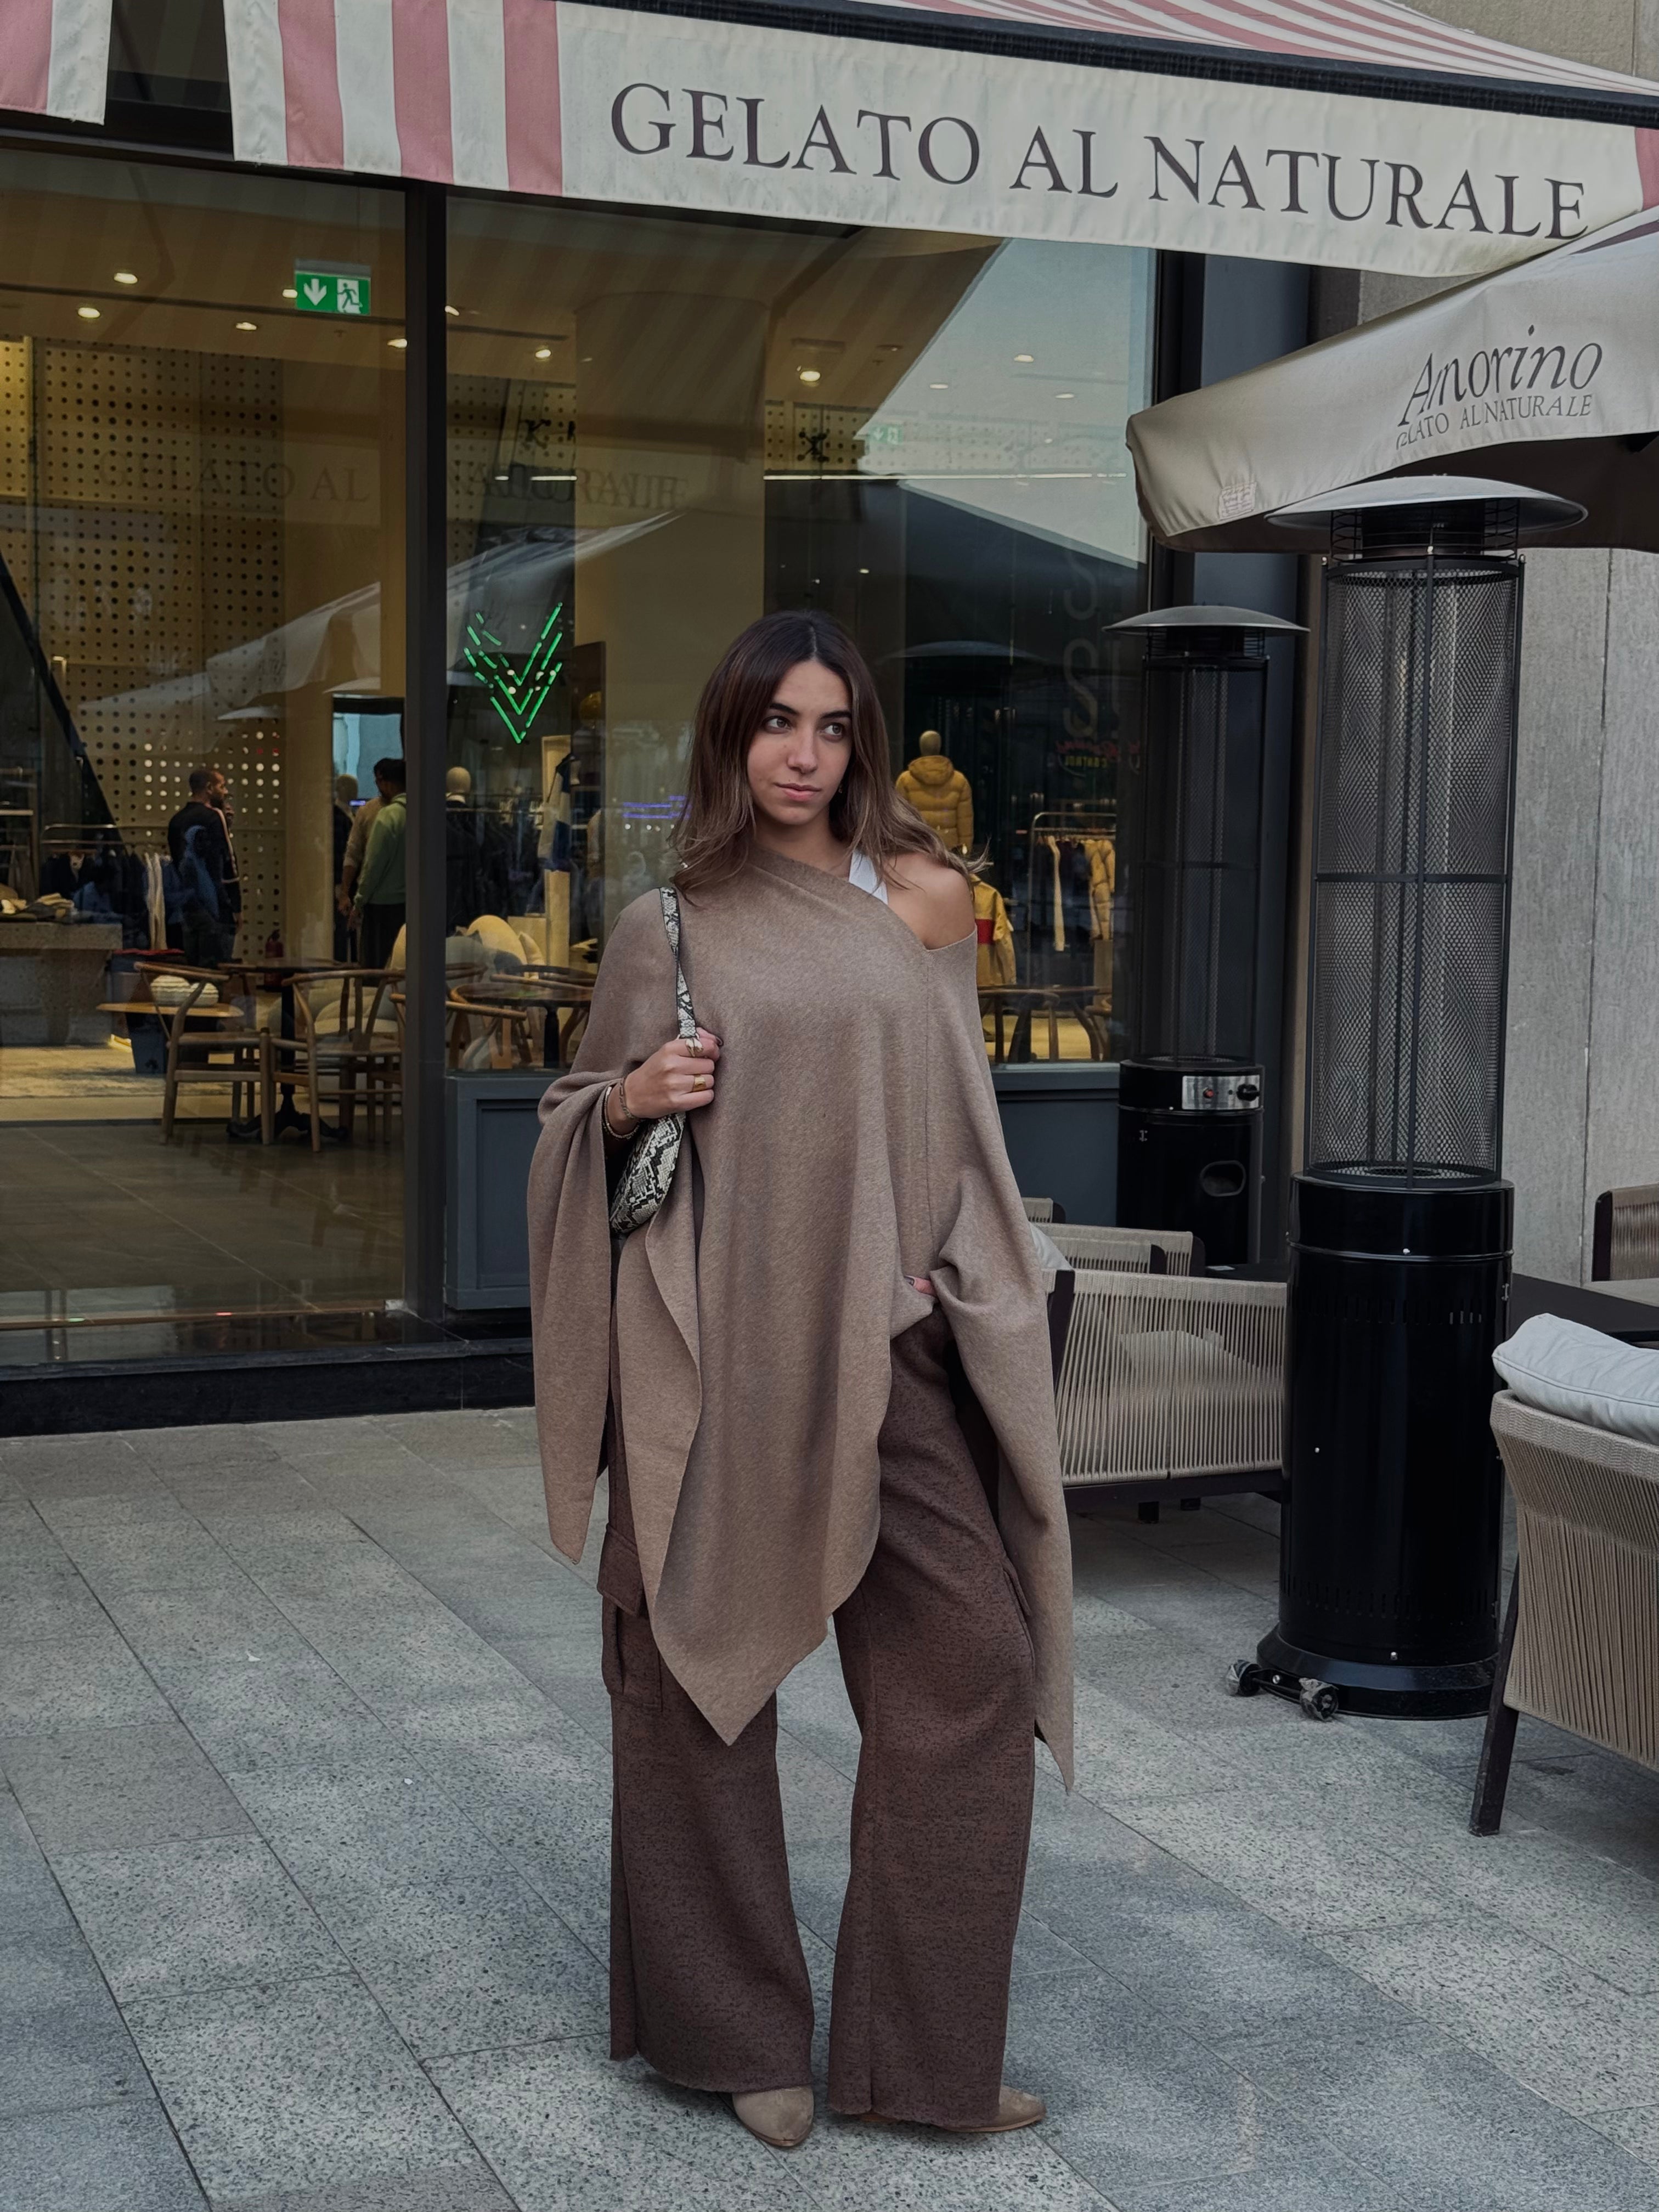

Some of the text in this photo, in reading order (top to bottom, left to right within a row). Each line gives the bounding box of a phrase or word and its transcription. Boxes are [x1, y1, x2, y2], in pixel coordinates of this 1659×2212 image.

[611, 82, 1588, 240] GELATO AL NATURALE
[1459, 402, 1482, 430] AL
[1483, 393, 1593, 425] NATURALE
